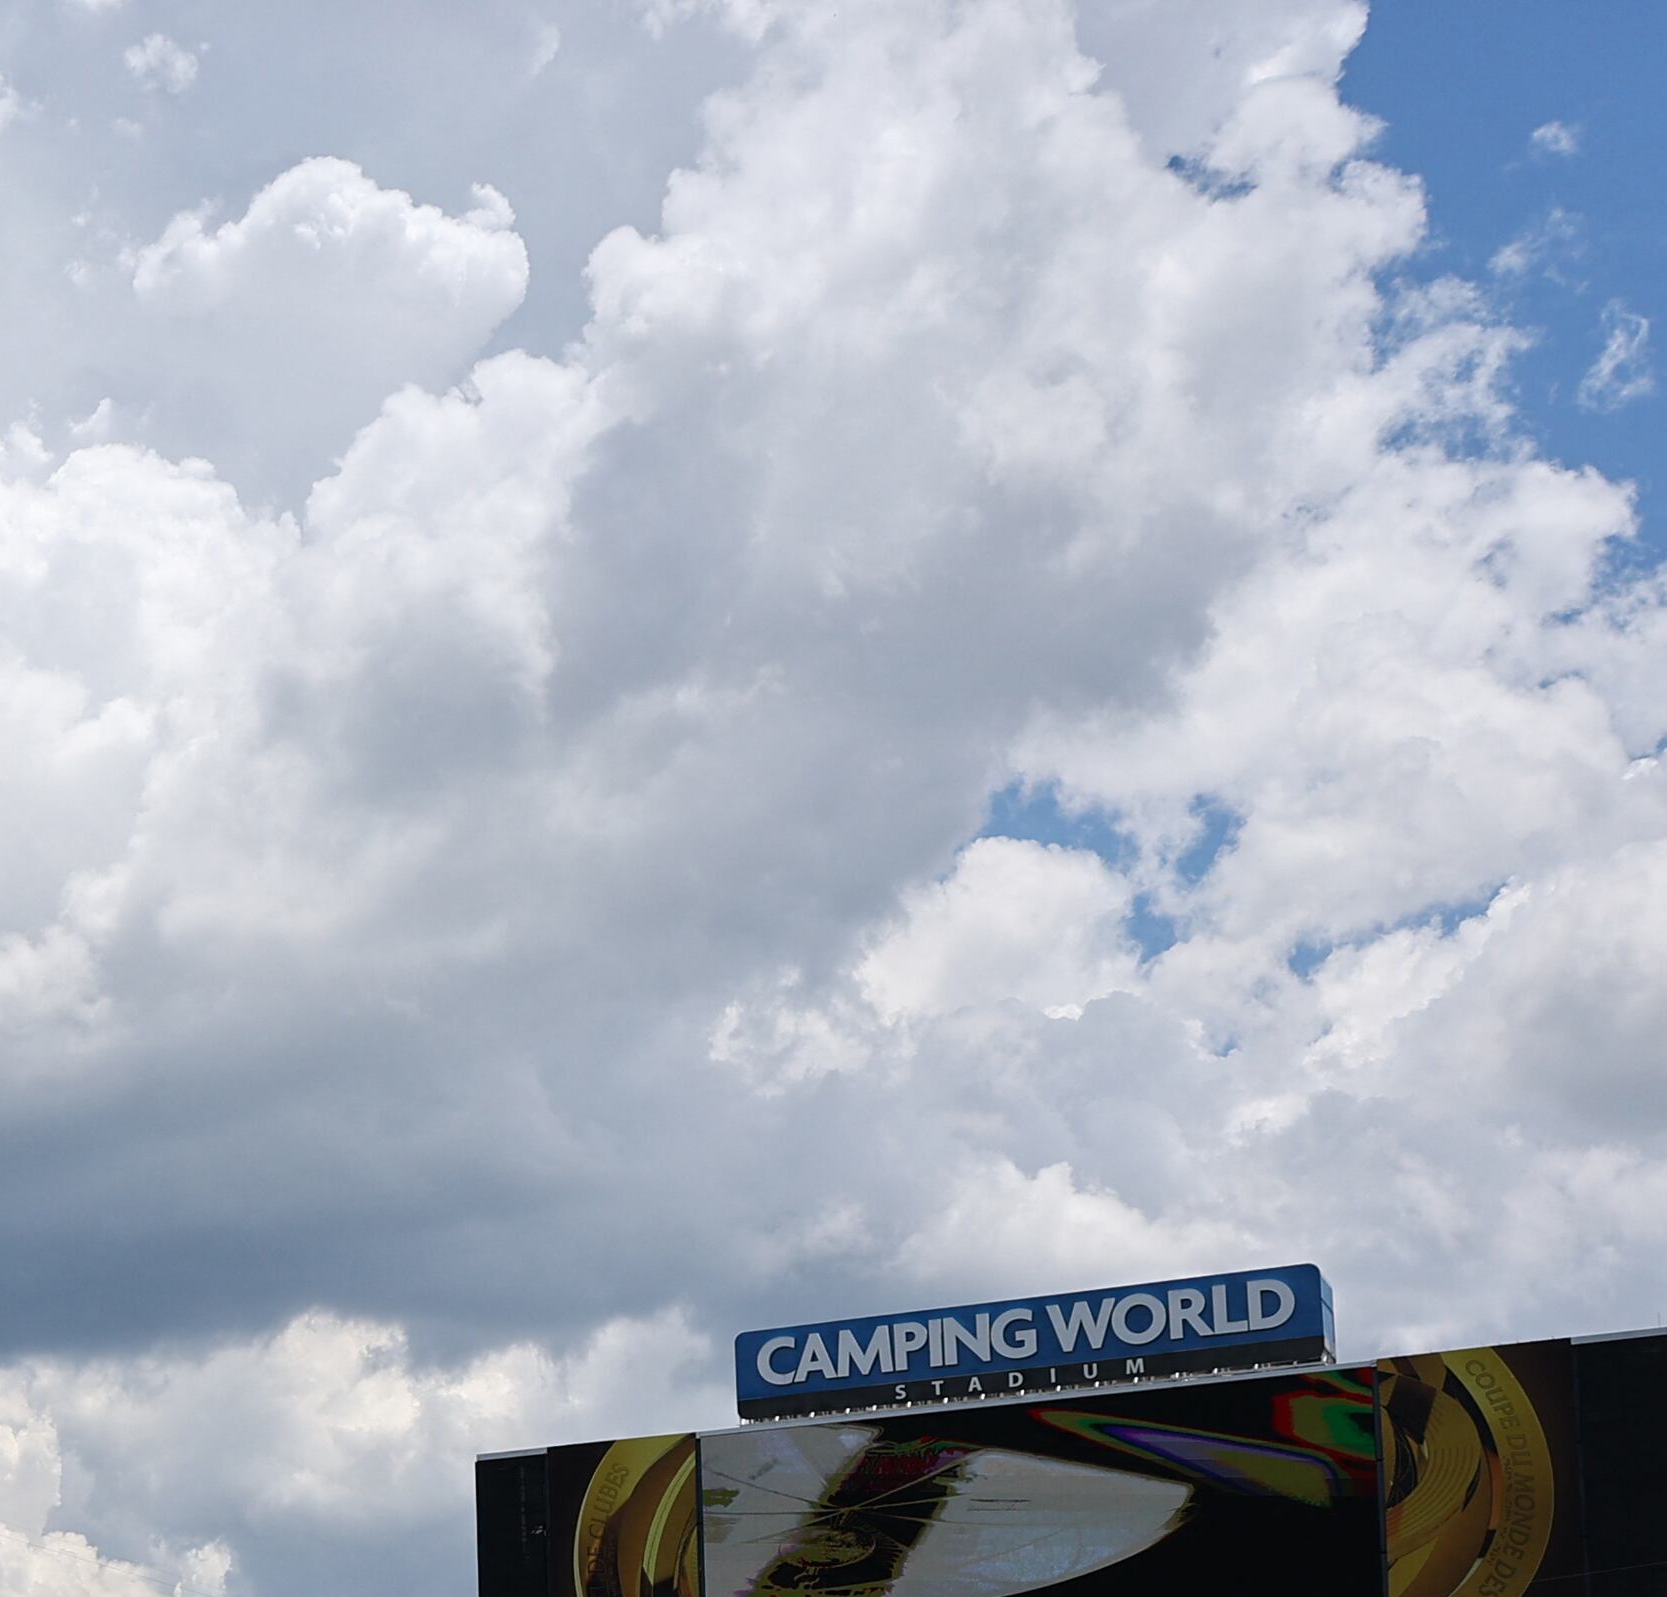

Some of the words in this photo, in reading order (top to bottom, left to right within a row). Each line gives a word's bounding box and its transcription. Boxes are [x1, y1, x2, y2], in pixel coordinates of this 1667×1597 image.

[755, 1308, 1038, 1387] CAMPING
[1046, 1278, 1296, 1354] WORLD
[895, 1356, 1145, 1401] STADIUM
[1505, 1472, 1536, 1556] MONDE
